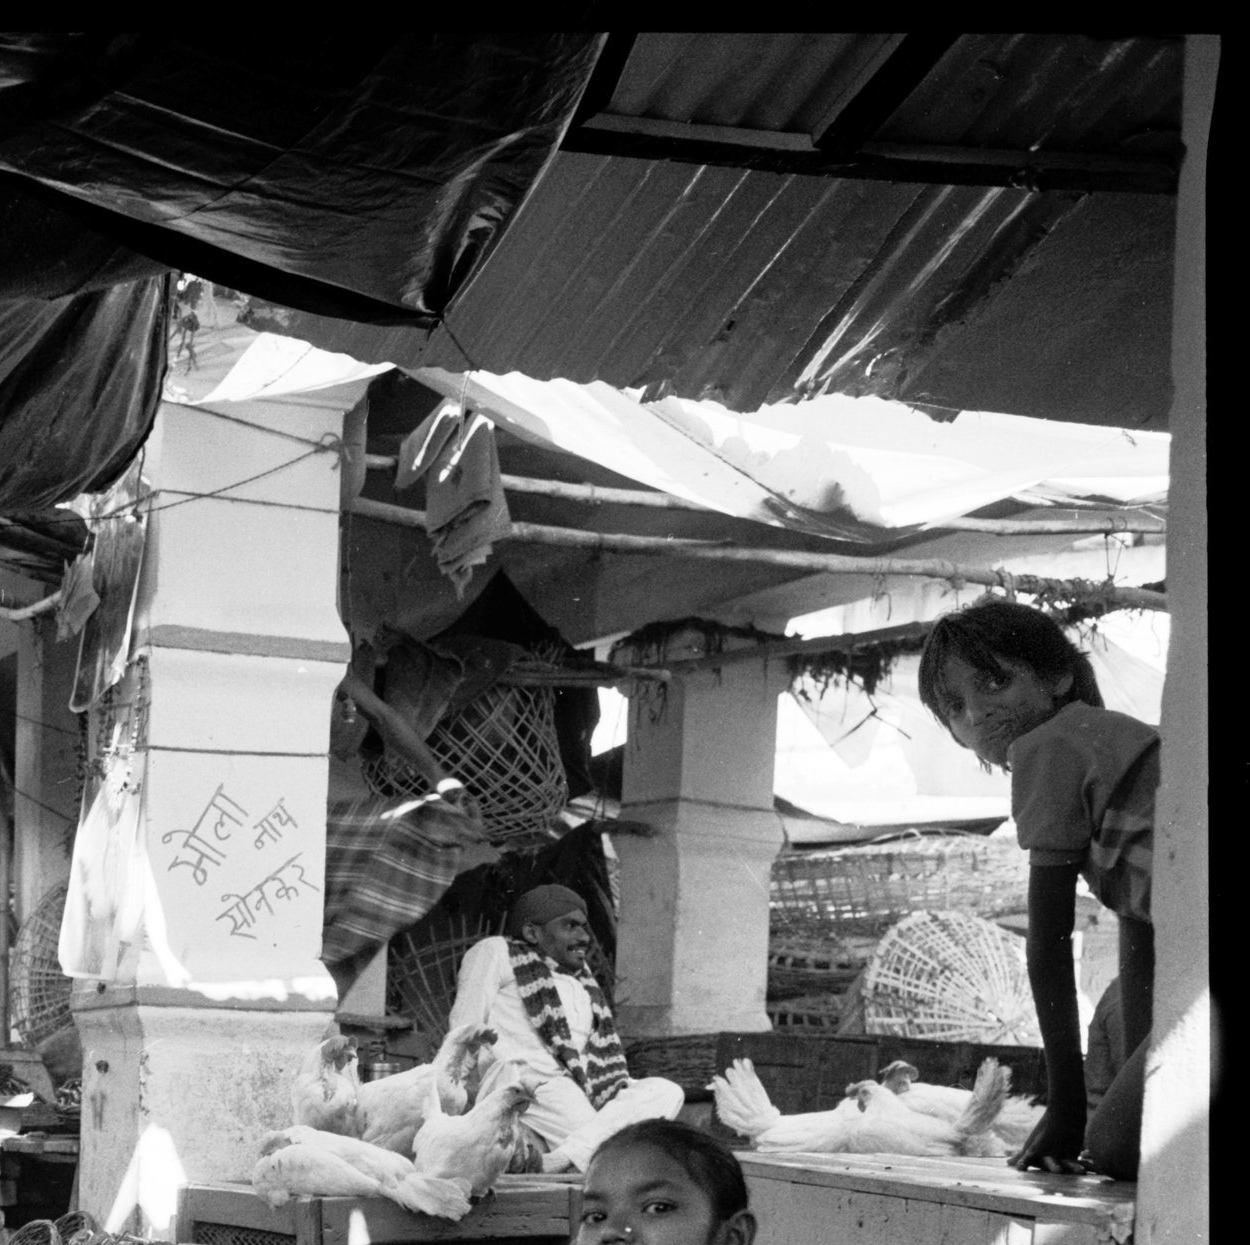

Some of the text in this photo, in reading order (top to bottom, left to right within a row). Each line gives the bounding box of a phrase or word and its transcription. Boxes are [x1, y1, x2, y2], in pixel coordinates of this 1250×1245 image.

[161, 783, 298, 886] भोला नाथ
[215, 852, 320, 940] सोनकर
